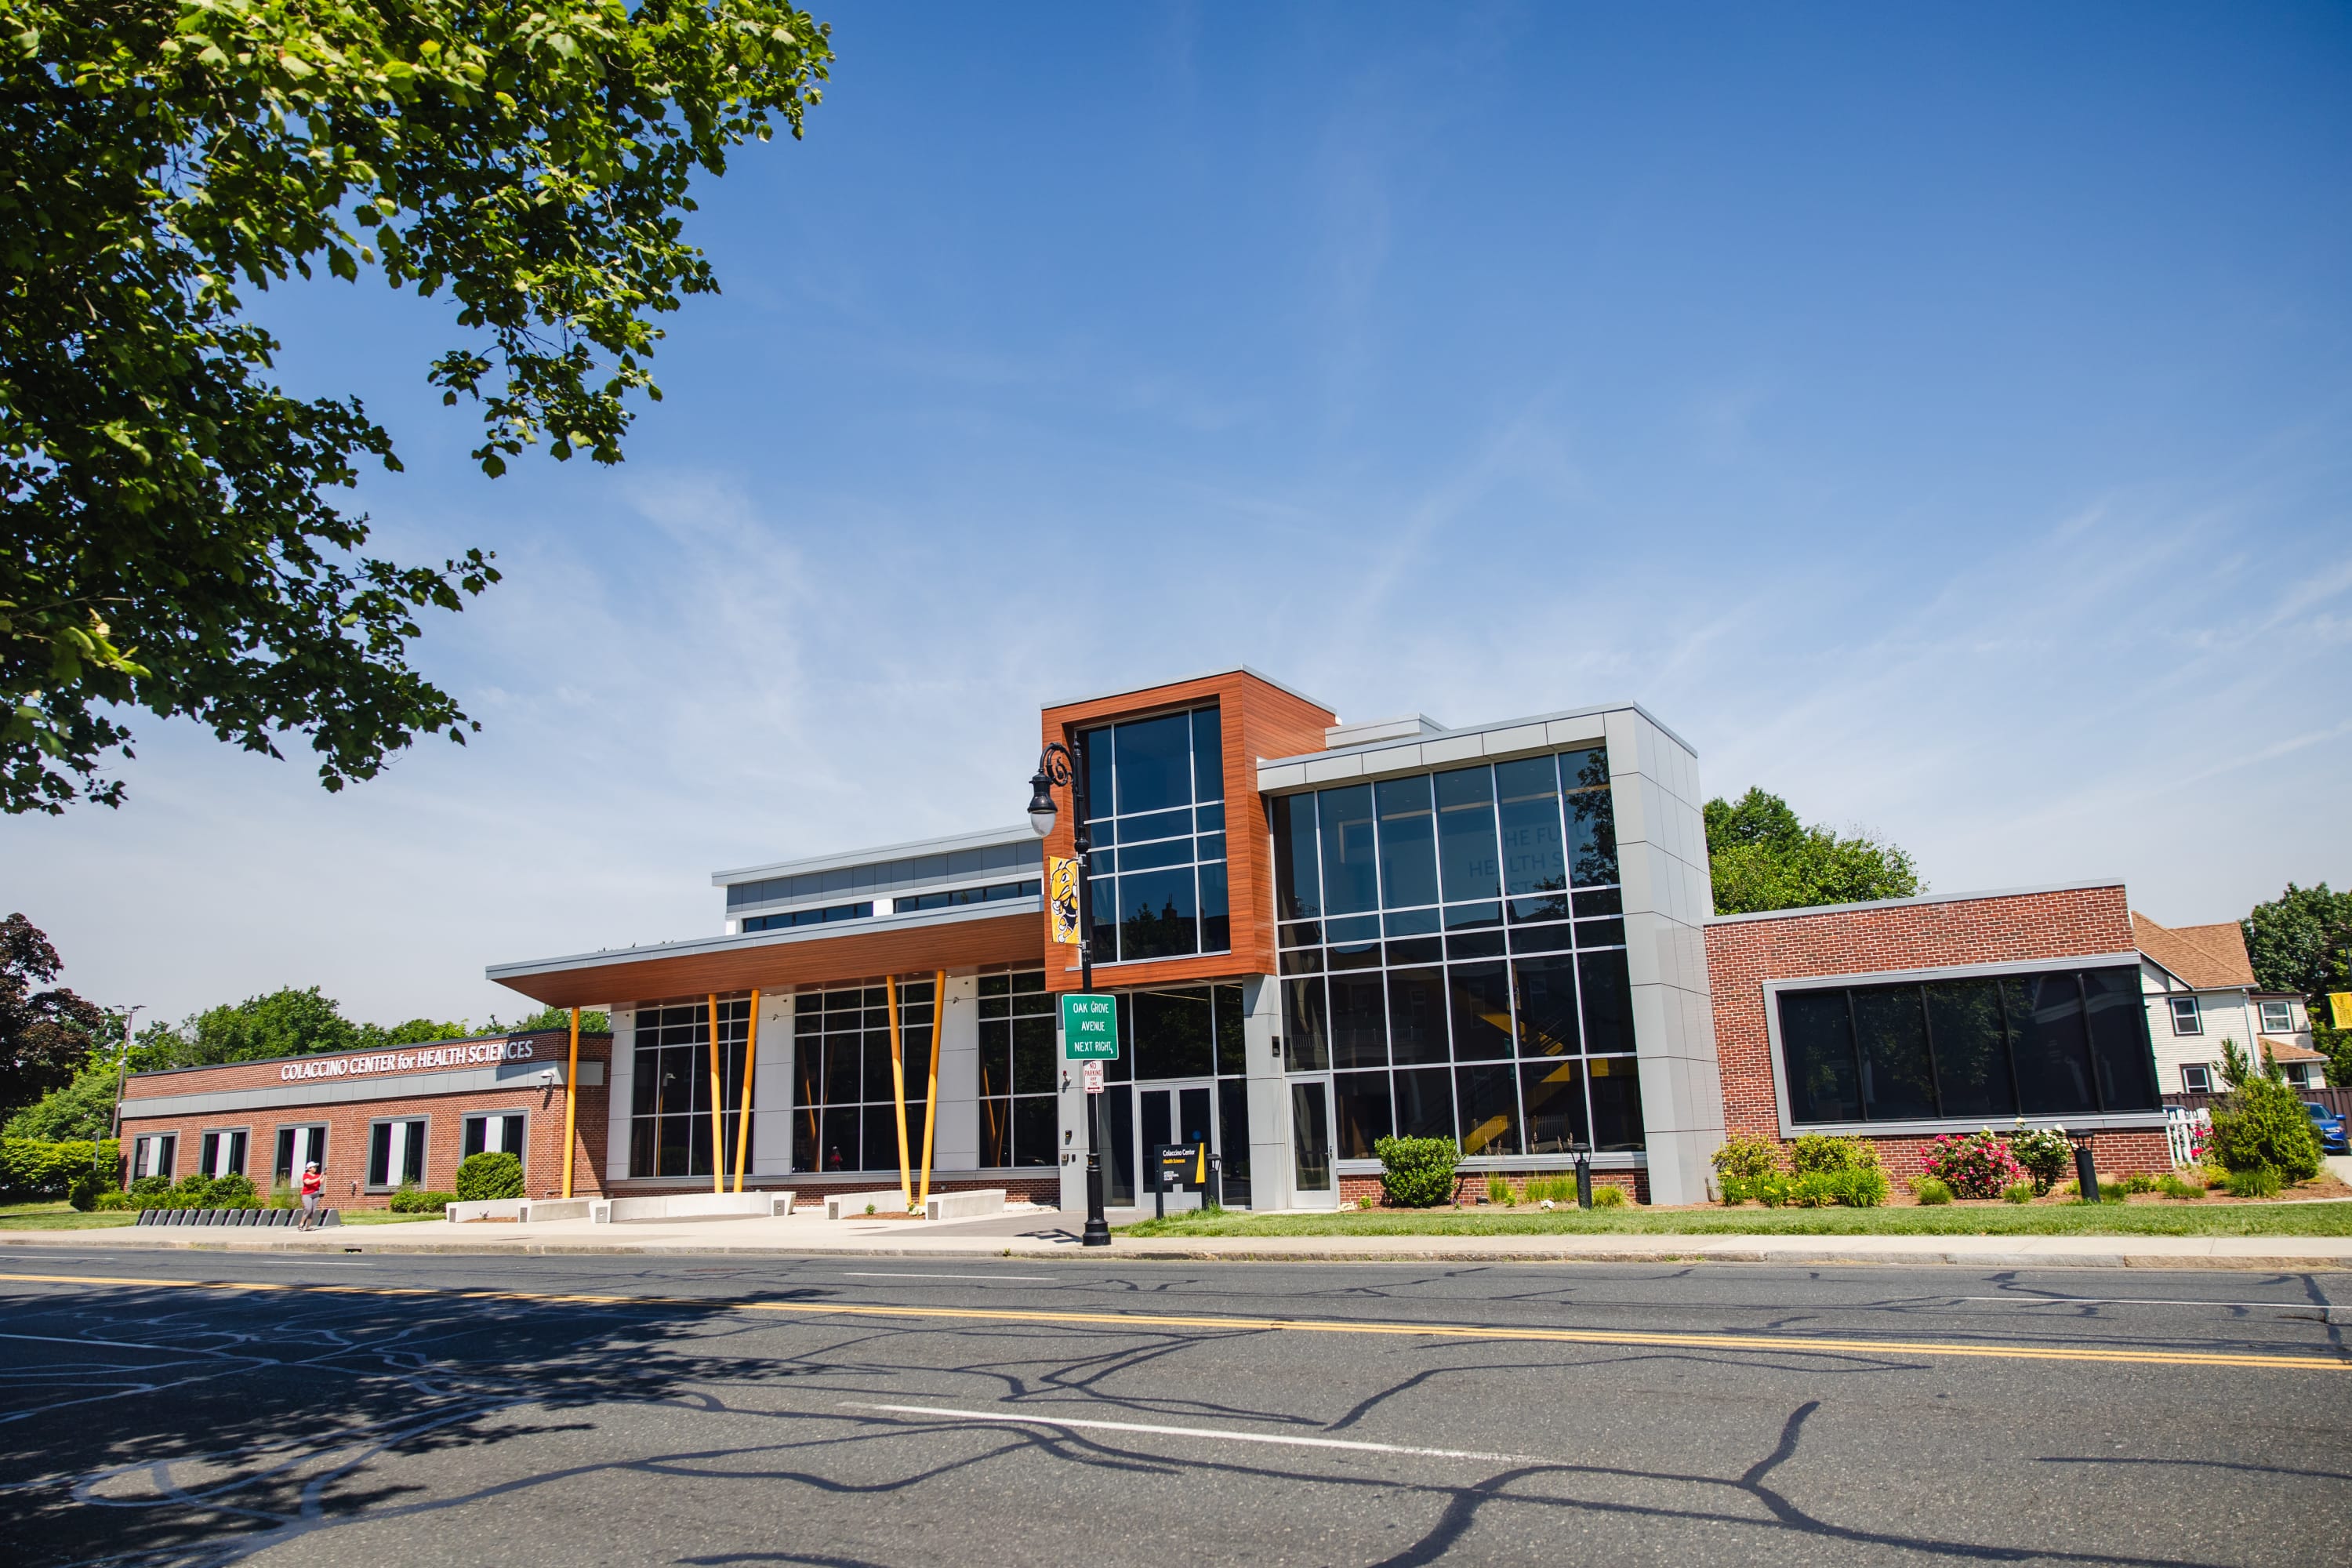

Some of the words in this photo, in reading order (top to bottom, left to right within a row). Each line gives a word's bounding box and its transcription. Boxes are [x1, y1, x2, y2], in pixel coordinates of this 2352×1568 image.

[1489, 829, 1530, 848] HE
[1468, 852, 1544, 878] HELTH
[1073, 1003, 1088, 1014] OAK
[1091, 1003, 1109, 1014] GROVE
[1081, 1021, 1105, 1032] AVENUE
[1074, 1041, 1093, 1052] NEXT
[1094, 1041, 1112, 1051] RIGHT
[281, 1058, 348, 1081] COLACCINO
[350, 1054, 395, 1075] CENTER
[397, 1054, 416, 1070] for
[417, 1047, 466, 1068] HEALTH
[468, 1040, 534, 1064] SCIENCES
